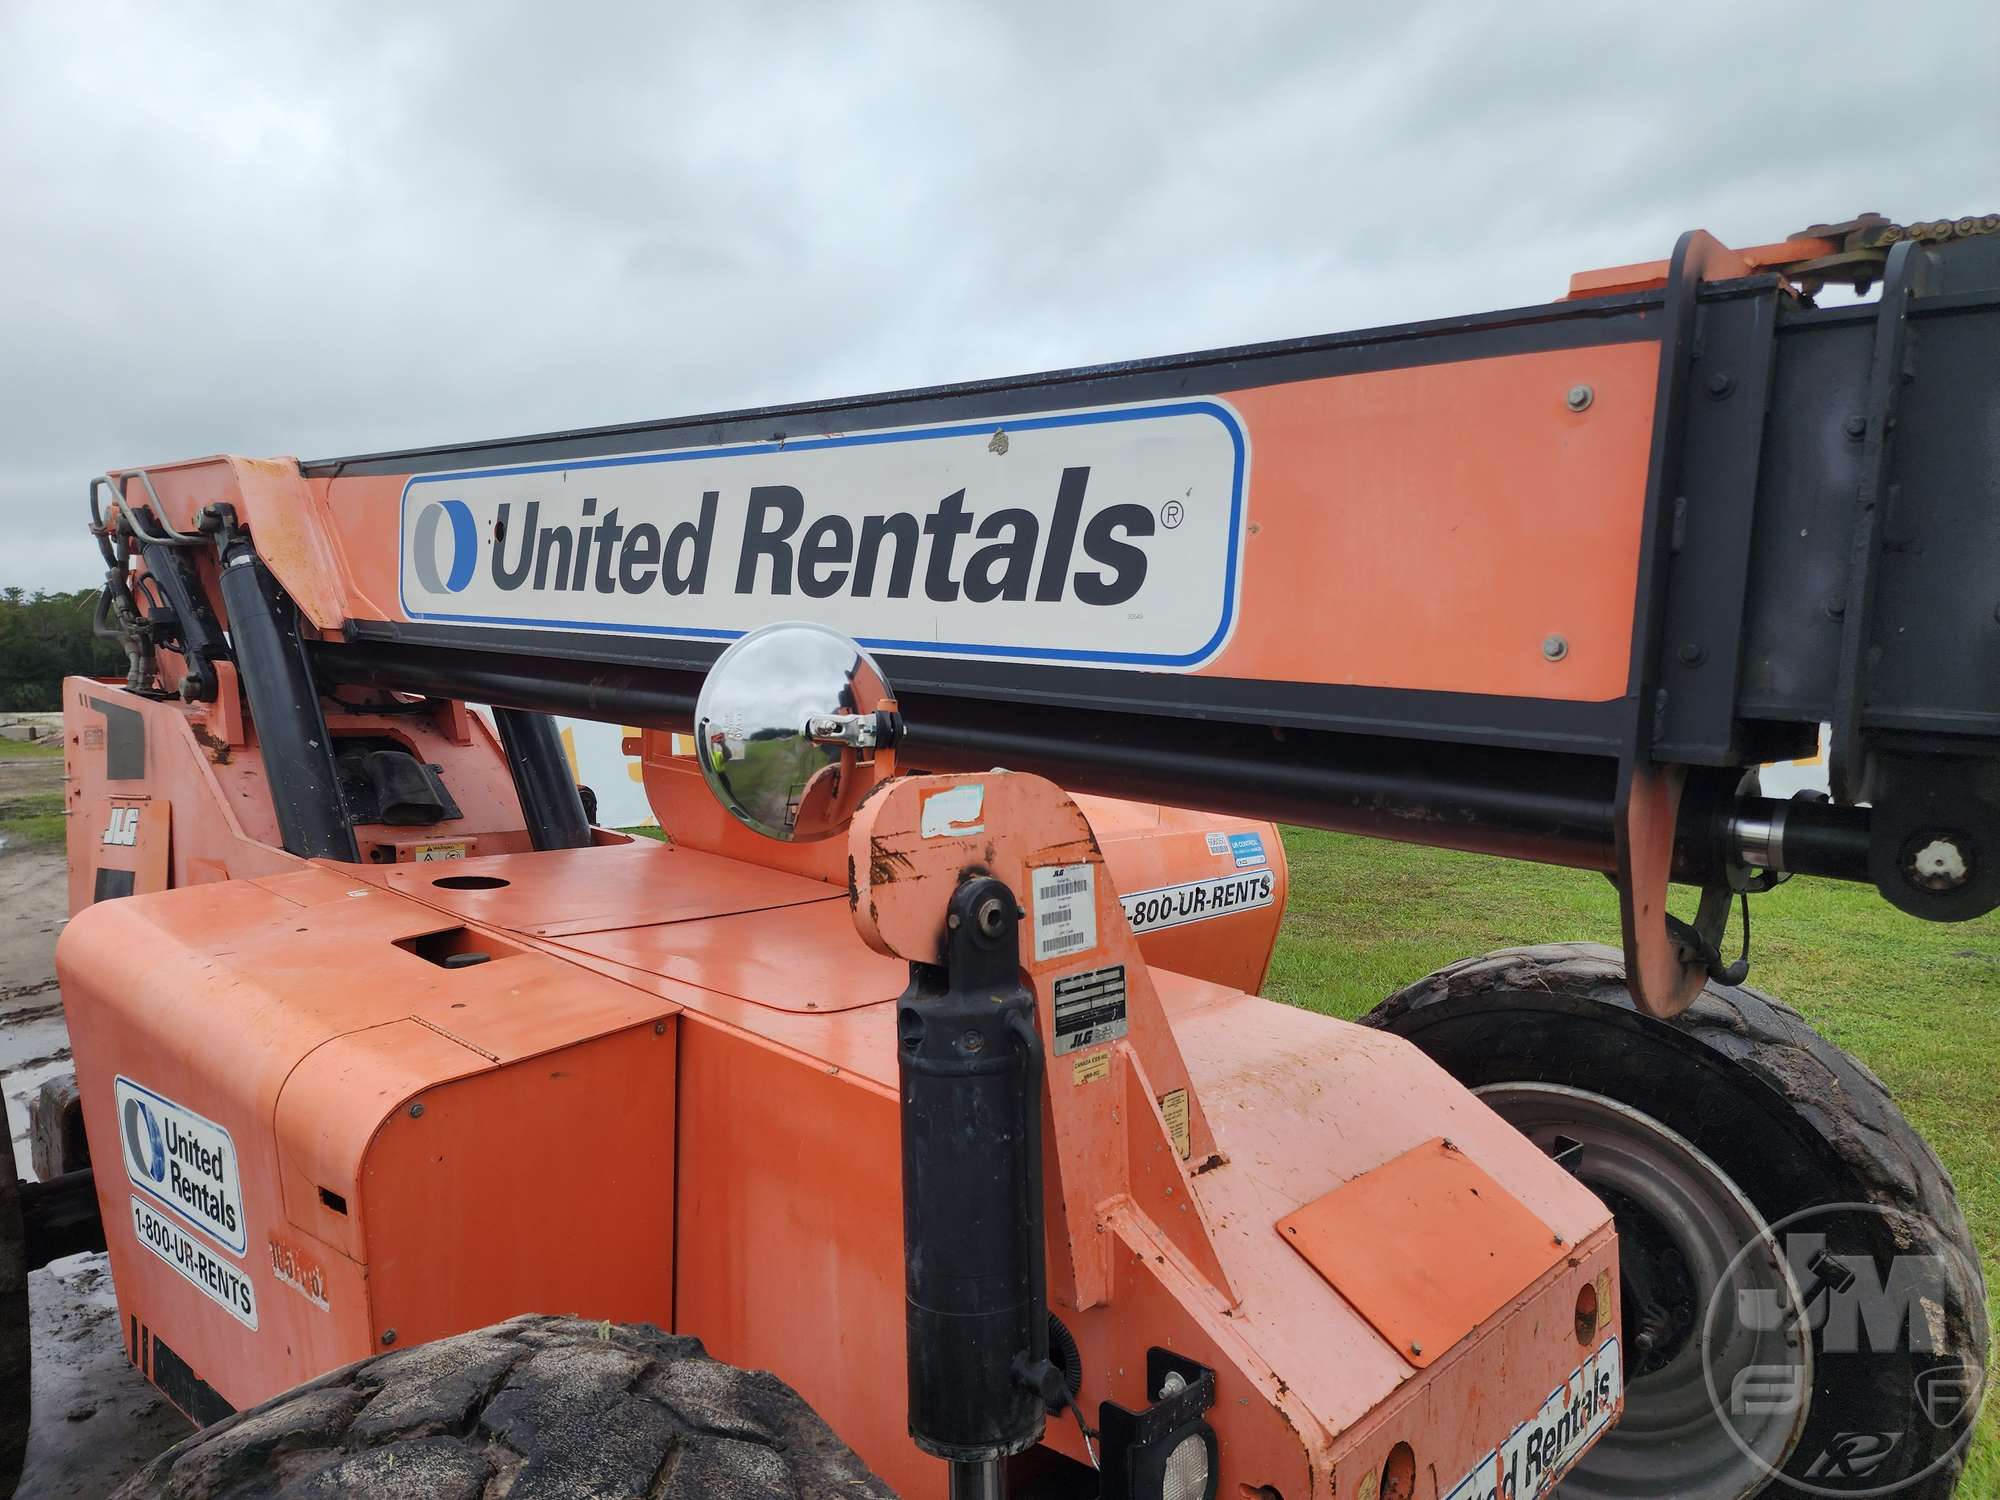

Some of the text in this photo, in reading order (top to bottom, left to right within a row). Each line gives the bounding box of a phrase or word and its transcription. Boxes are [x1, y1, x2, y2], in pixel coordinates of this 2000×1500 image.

[491, 491, 720, 597] United
[734, 466, 1156, 606] Rentals
[103, 807, 140, 847] JLG
[1070, 1029, 1094, 1049] JLG
[164, 1117, 224, 1184] United
[170, 1159, 237, 1234] Rentals
[134, 1207, 253, 1315] 1-800-UR-RENTS
[1525, 1368, 1610, 1488] Rentals
